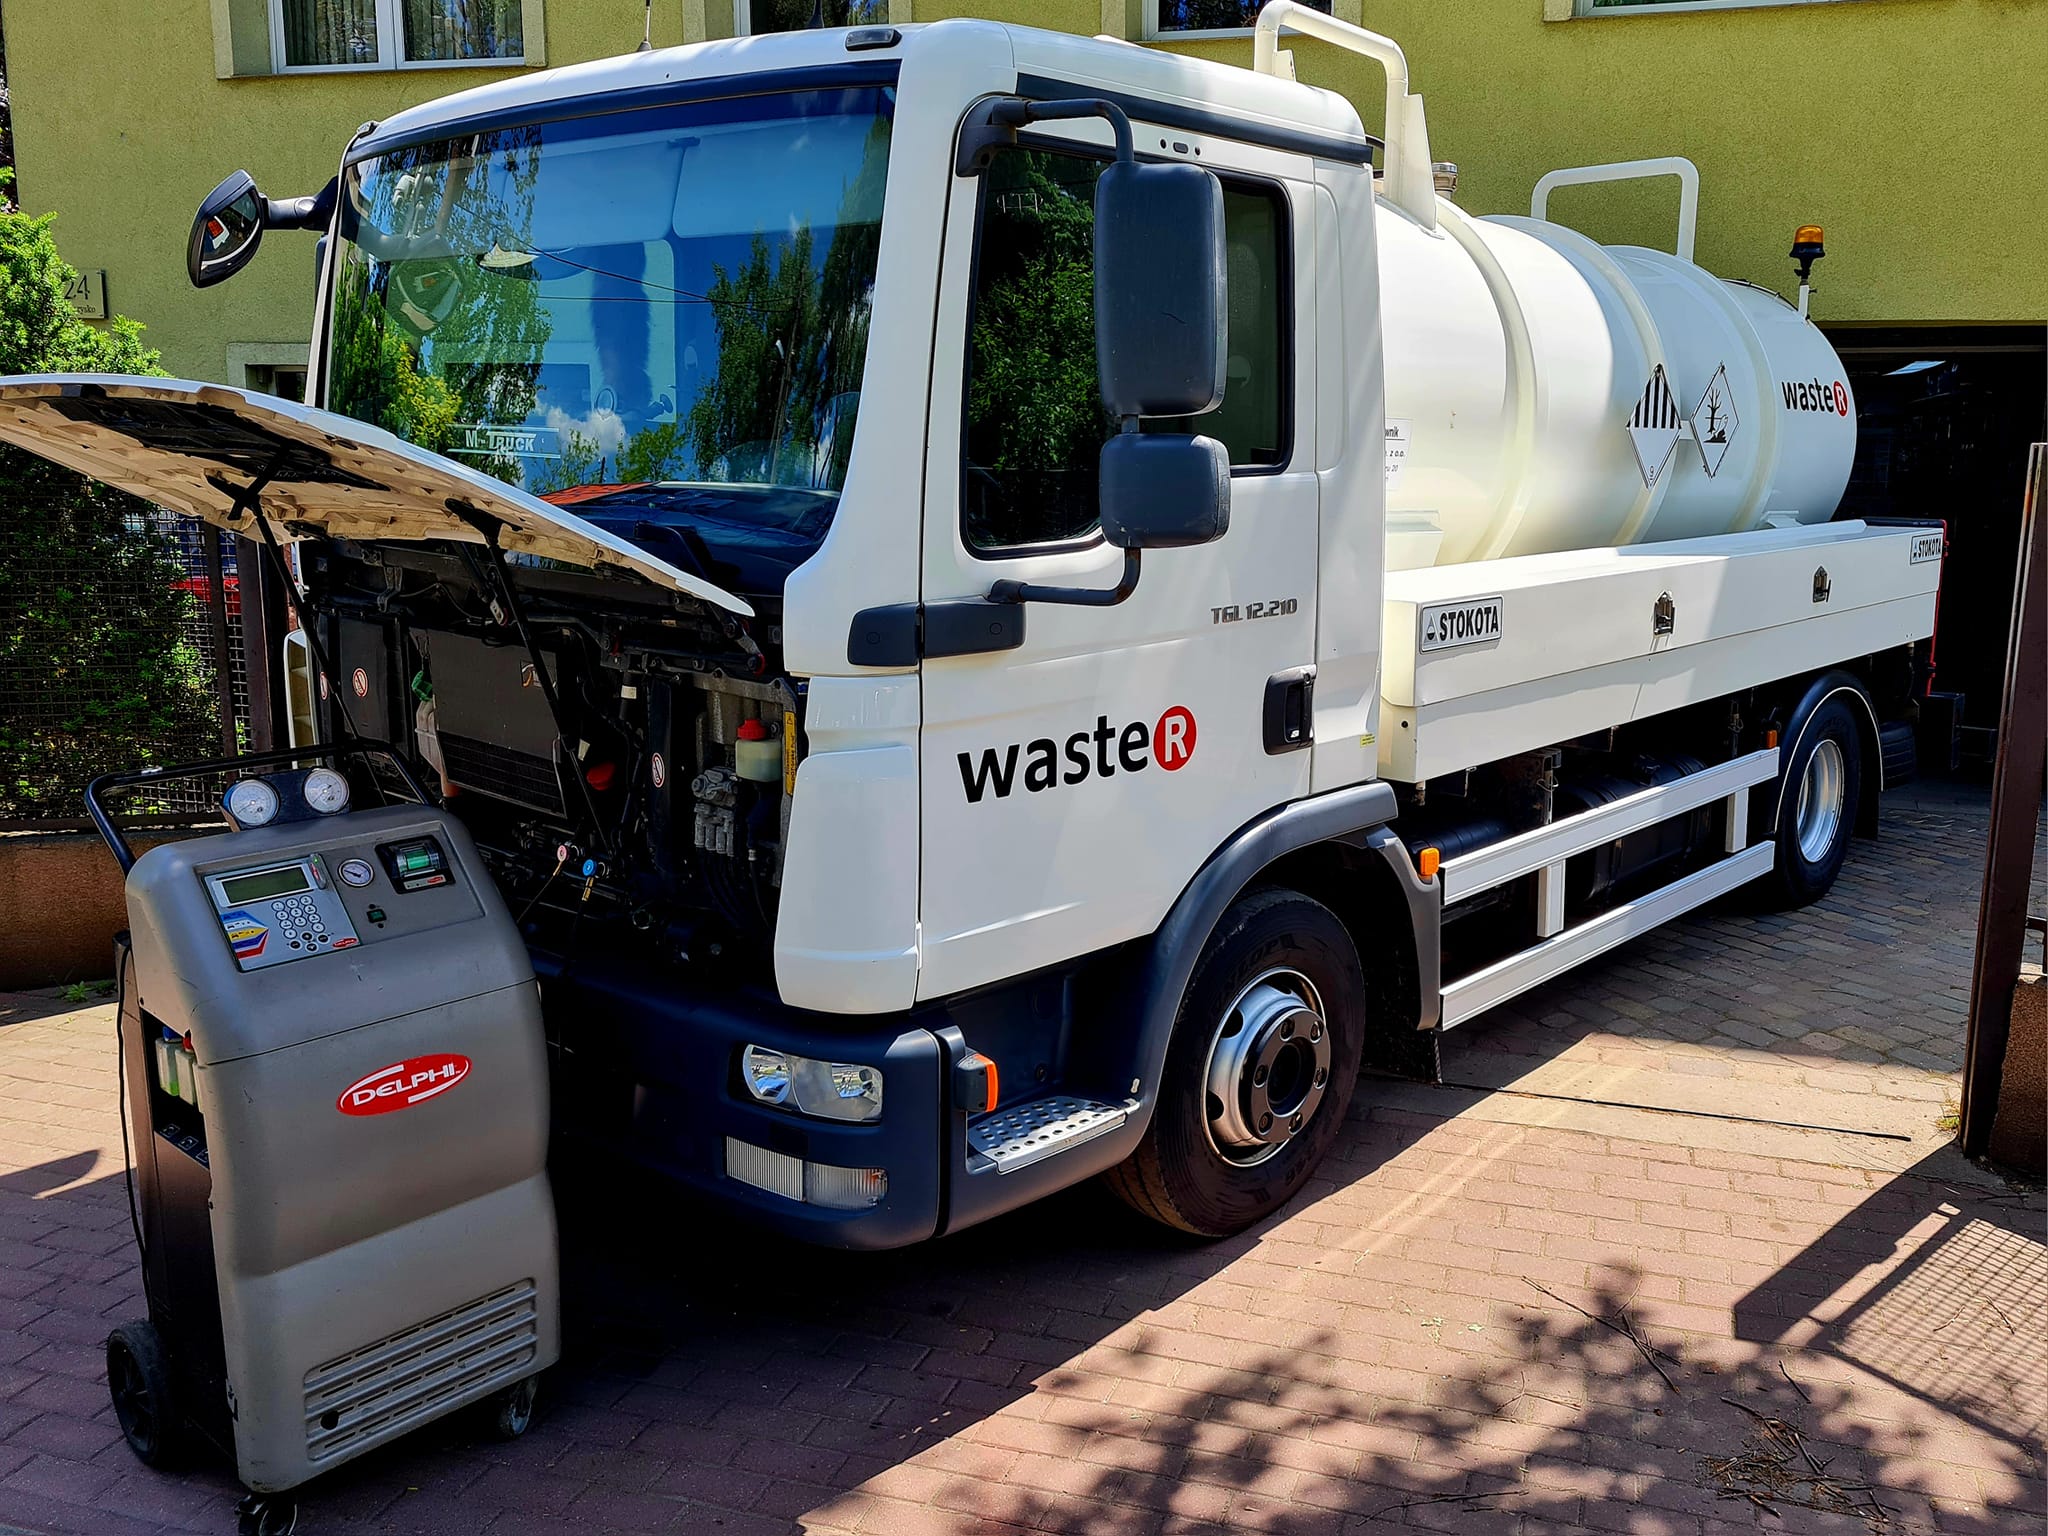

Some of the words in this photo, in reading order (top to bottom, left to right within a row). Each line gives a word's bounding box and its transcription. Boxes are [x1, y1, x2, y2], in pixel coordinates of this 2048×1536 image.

[64, 275, 90, 300] 24
[1781, 377, 1848, 415] wasteR
[1918, 537, 1942, 558] STOKOTA
[1211, 605, 1243, 625] TGL
[1246, 598, 1298, 620] 12.210
[1440, 605, 1499, 641] STOKOTA
[956, 712, 1192, 804] wasteR
[352, 1062, 456, 1107] DELPHI
